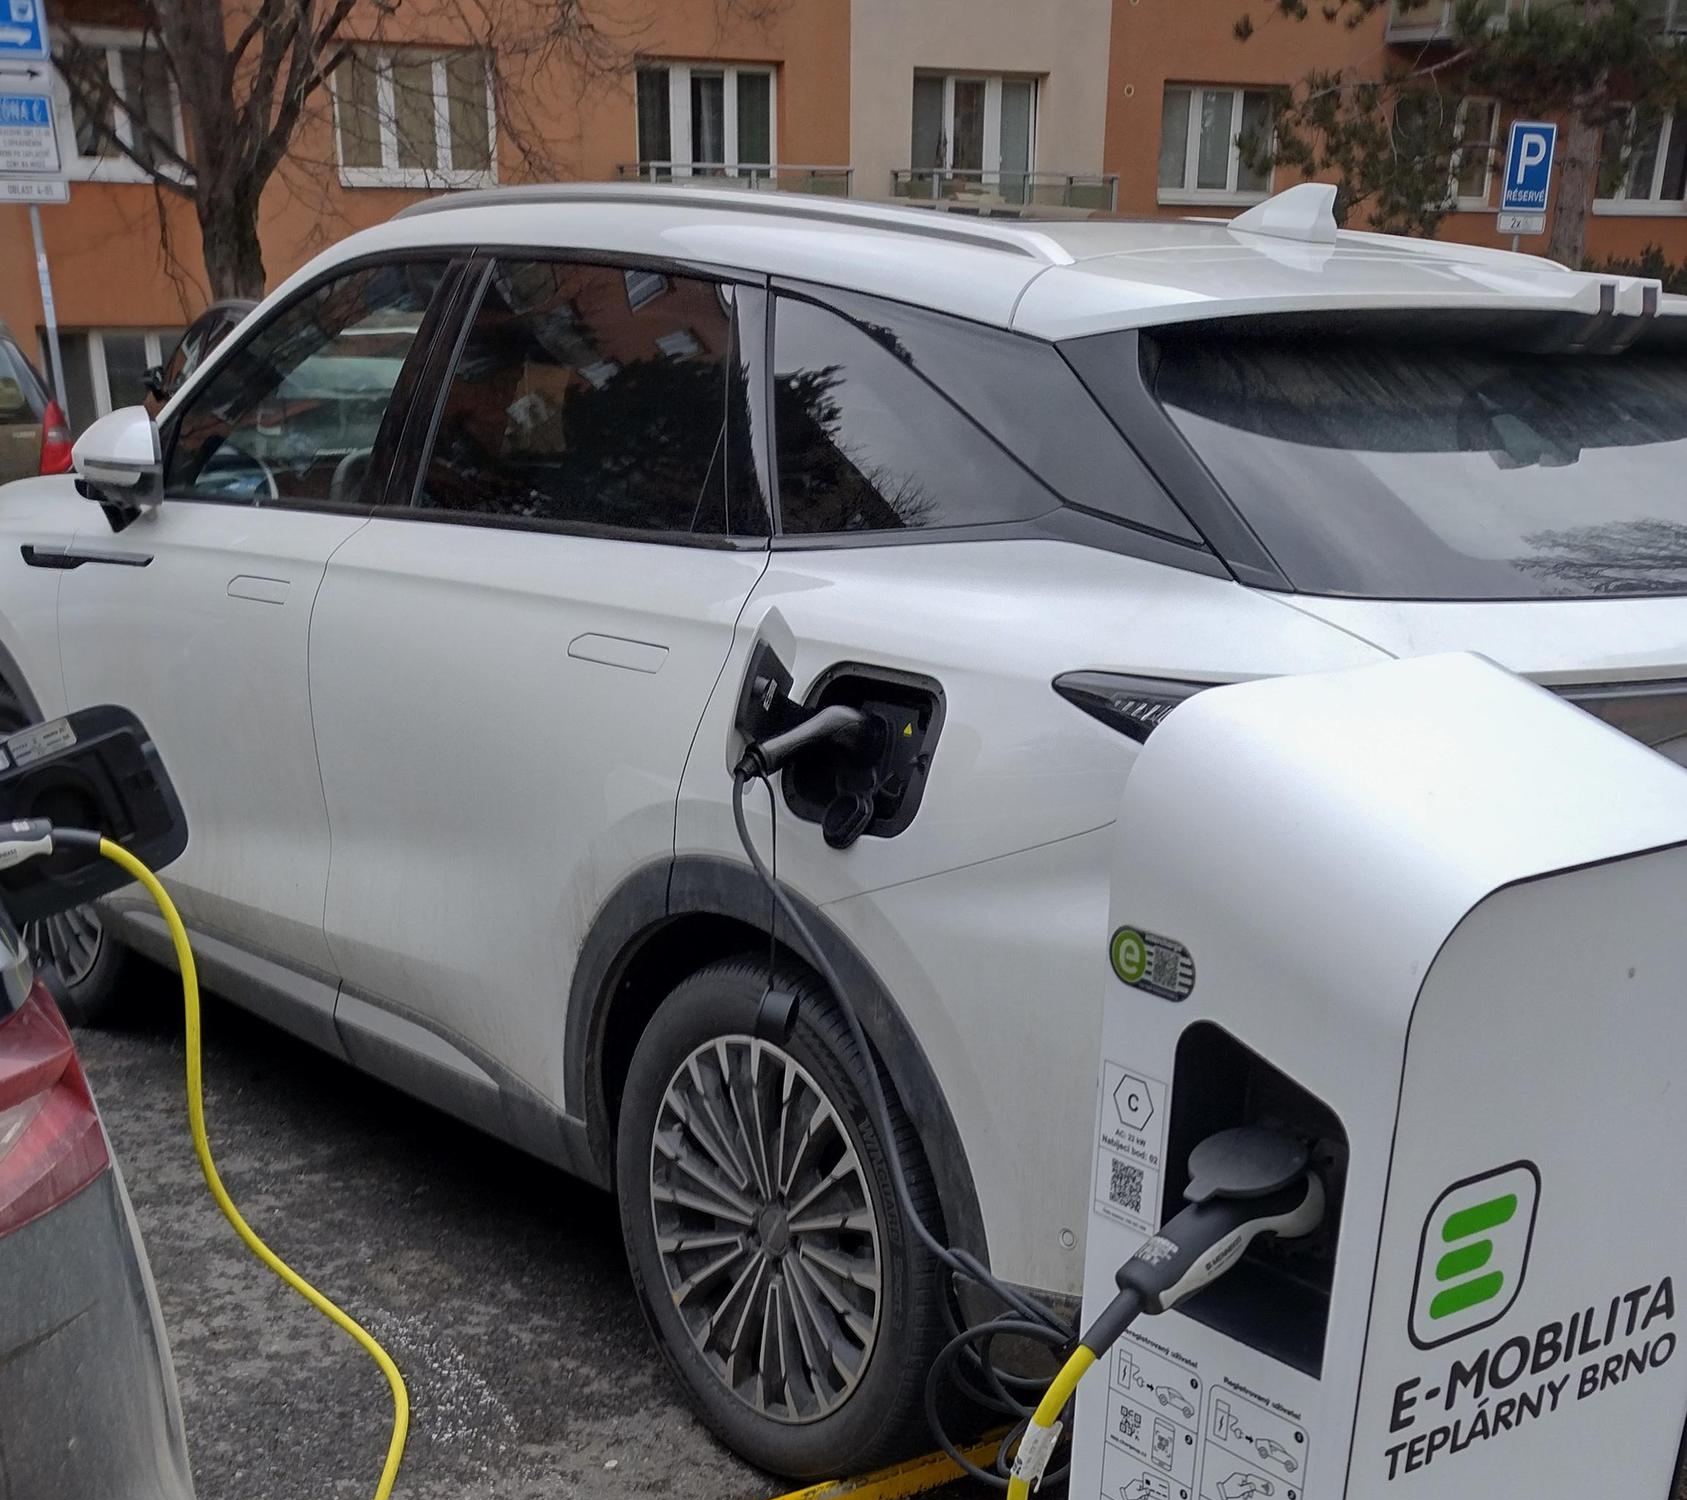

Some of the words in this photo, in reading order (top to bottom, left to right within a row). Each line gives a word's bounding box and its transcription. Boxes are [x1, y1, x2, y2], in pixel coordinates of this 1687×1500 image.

[1516, 133, 1547, 185] P
[1127, 1093, 1140, 1113] C
[1389, 1275, 1675, 1434] E-MOBILITA
[1384, 1373, 1570, 1481] TEPLÁRNY
[1577, 1332, 1677, 1400] BRNO
